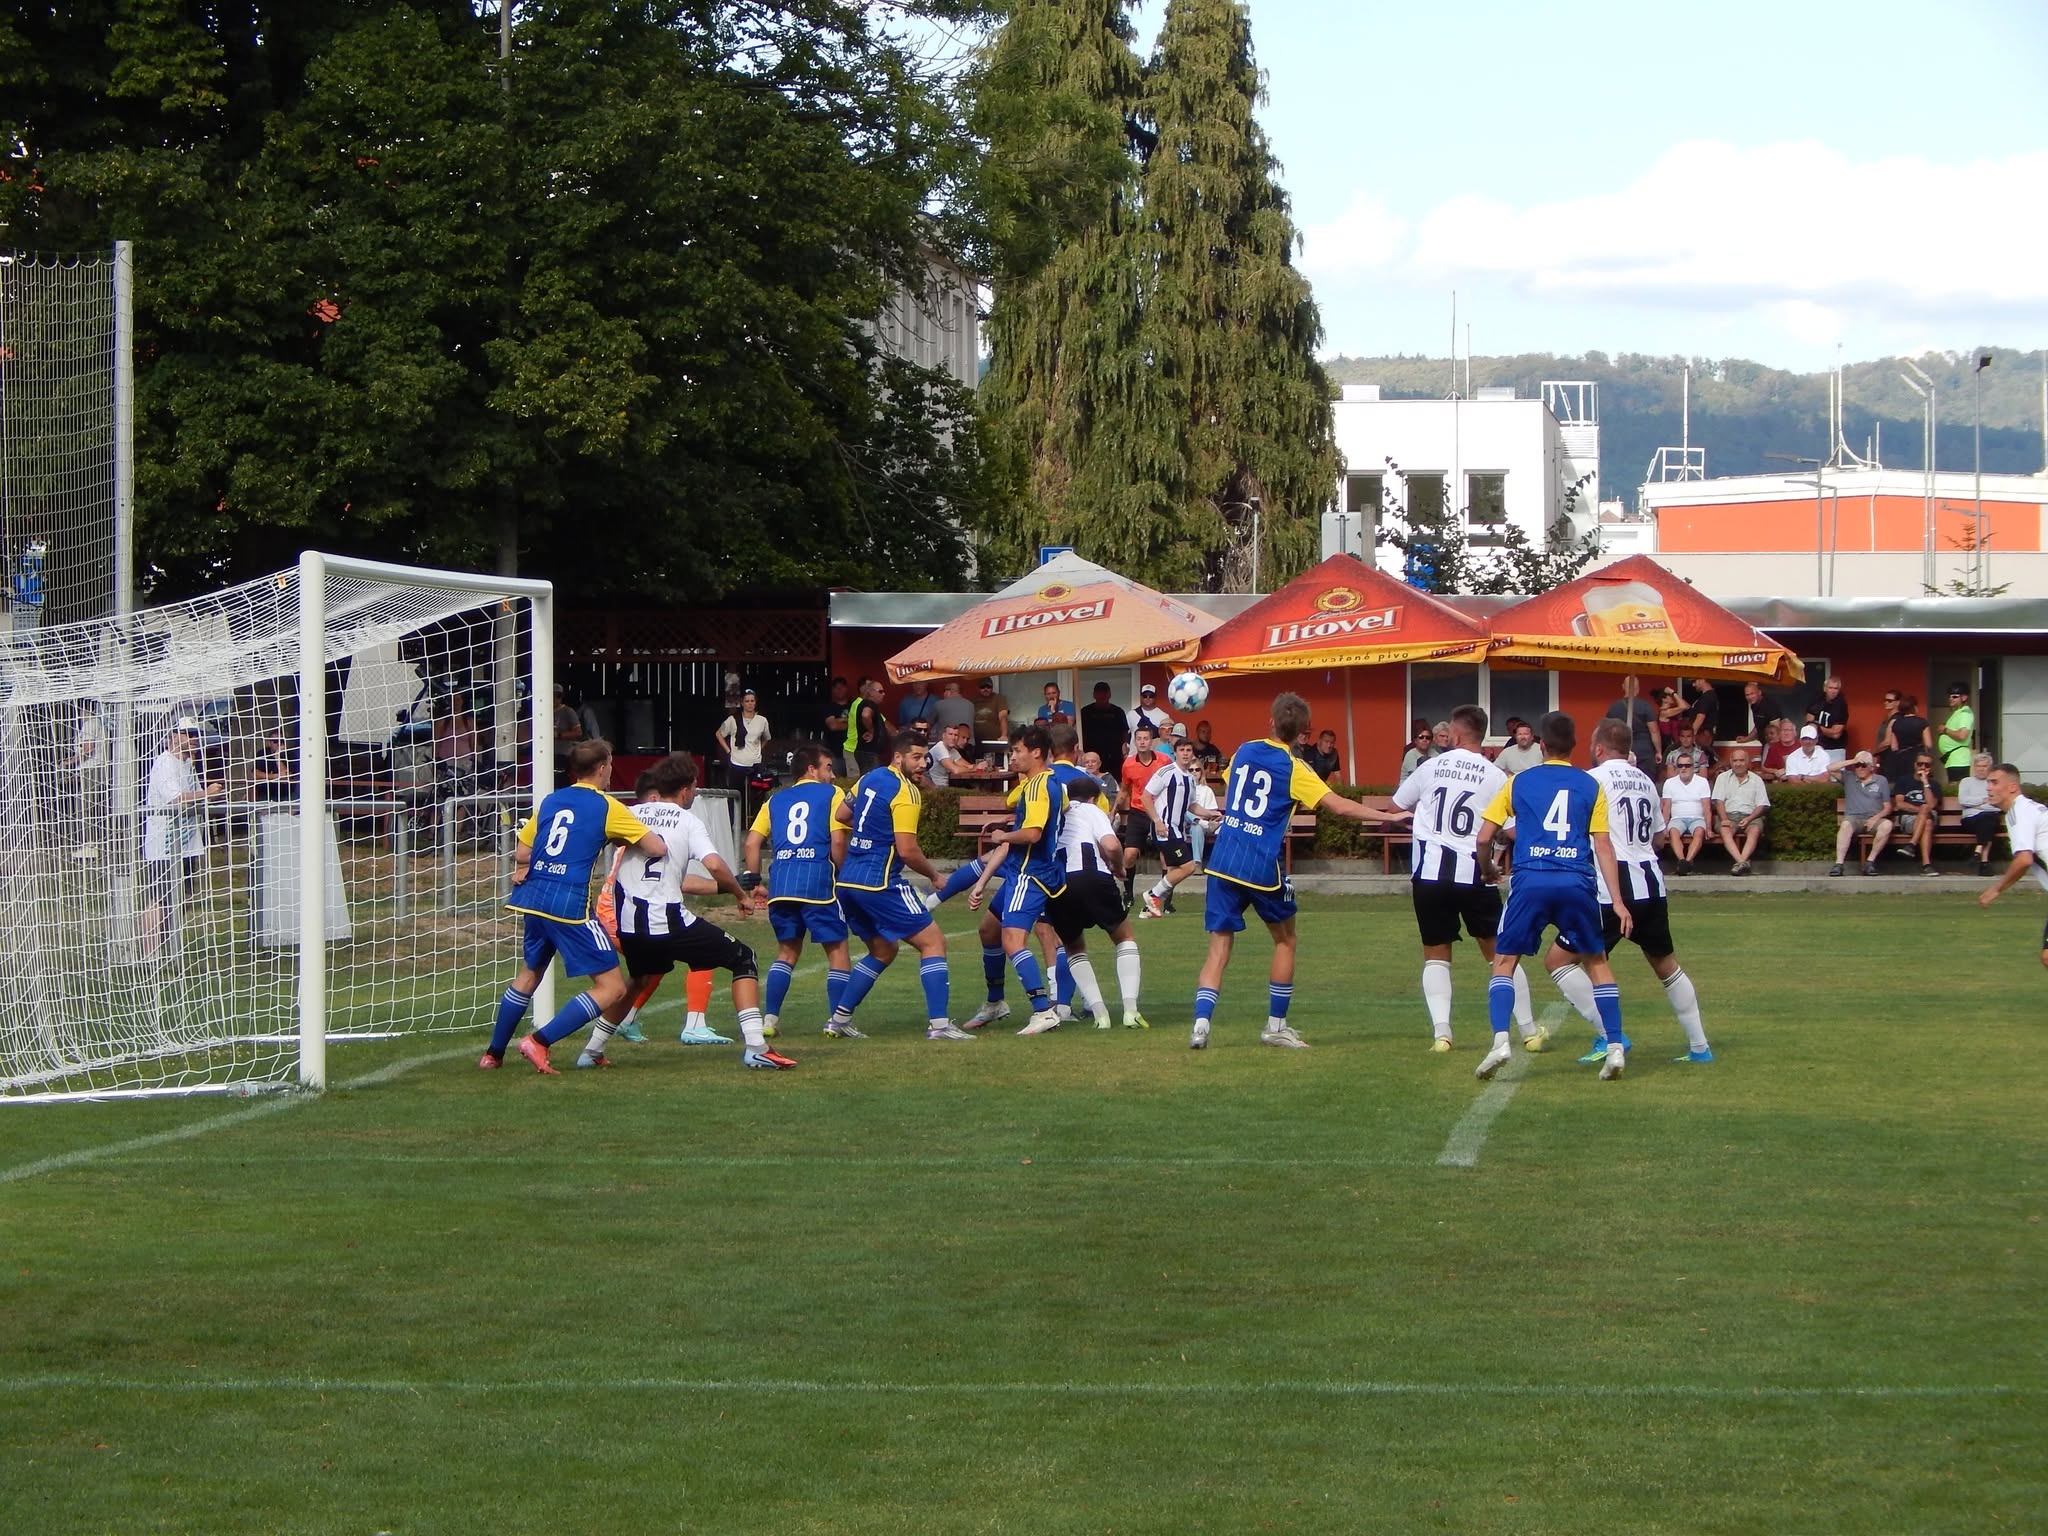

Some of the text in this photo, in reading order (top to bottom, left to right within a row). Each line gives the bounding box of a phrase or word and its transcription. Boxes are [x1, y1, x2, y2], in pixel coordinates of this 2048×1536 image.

[985, 600, 1106, 637] Litovel
[1267, 610, 1396, 648] Litovel
[1619, 621, 1665, 632] Litovel
[1146, 640, 1183, 656] Litovel
[1378, 651, 1409, 662] pivo
[1537, 642, 1700, 659] Klasicky vařené pivo
[1723, 653, 1766, 666] Litovel
[1029, 654, 1063, 671] pivo
[1434, 768, 1484, 785] HODOLANY
[1437, 759, 1486, 774] FC SIGMA
[1609, 770, 1621, 778] FC
[1231, 764, 1272, 818] 13
[639, 806, 650, 815] FC
[786, 801, 809, 845] 8
[857, 788, 877, 833] 7
[1431, 786, 1475, 838] 16
[1543, 789, 1570, 840] 4
[1617, 796, 1653, 846] 18
[545, 809, 574, 857] 6
[641, 833, 666, 881] 2
